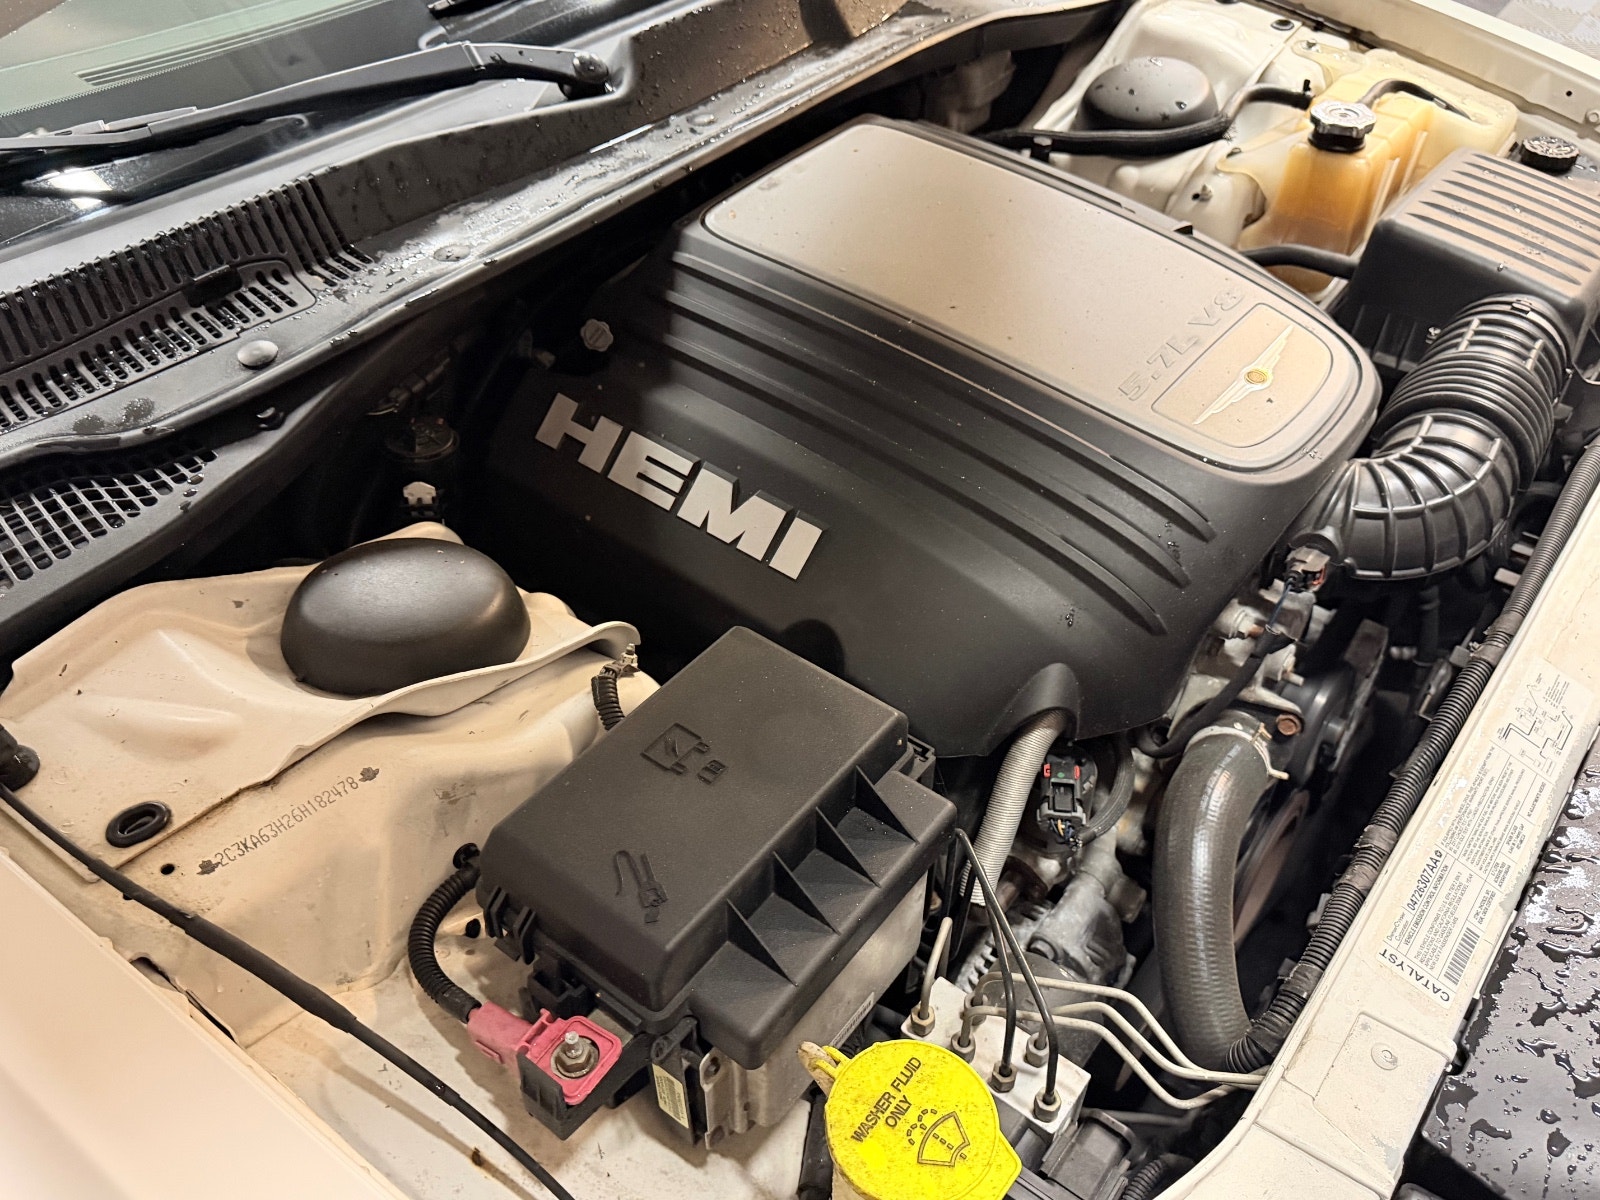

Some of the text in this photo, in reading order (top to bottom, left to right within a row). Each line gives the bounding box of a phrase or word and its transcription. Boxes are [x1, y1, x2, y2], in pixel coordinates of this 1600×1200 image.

[1118, 288, 1246, 401] 5.7L V8
[535, 392, 824, 580] HEMI
[214, 776, 359, 868] 2C3KA63H26H182478
[1403, 862, 1449, 946] VEHICLE EMISSION CONTROL INFORMATION
[1405, 854, 1440, 911] 04726307AA
[1379, 948, 1451, 1003] CATALYST
[851, 1091, 897, 1144] WASHER
[890, 1056, 923, 1094] FLUID
[885, 1094, 913, 1130] ONLY
